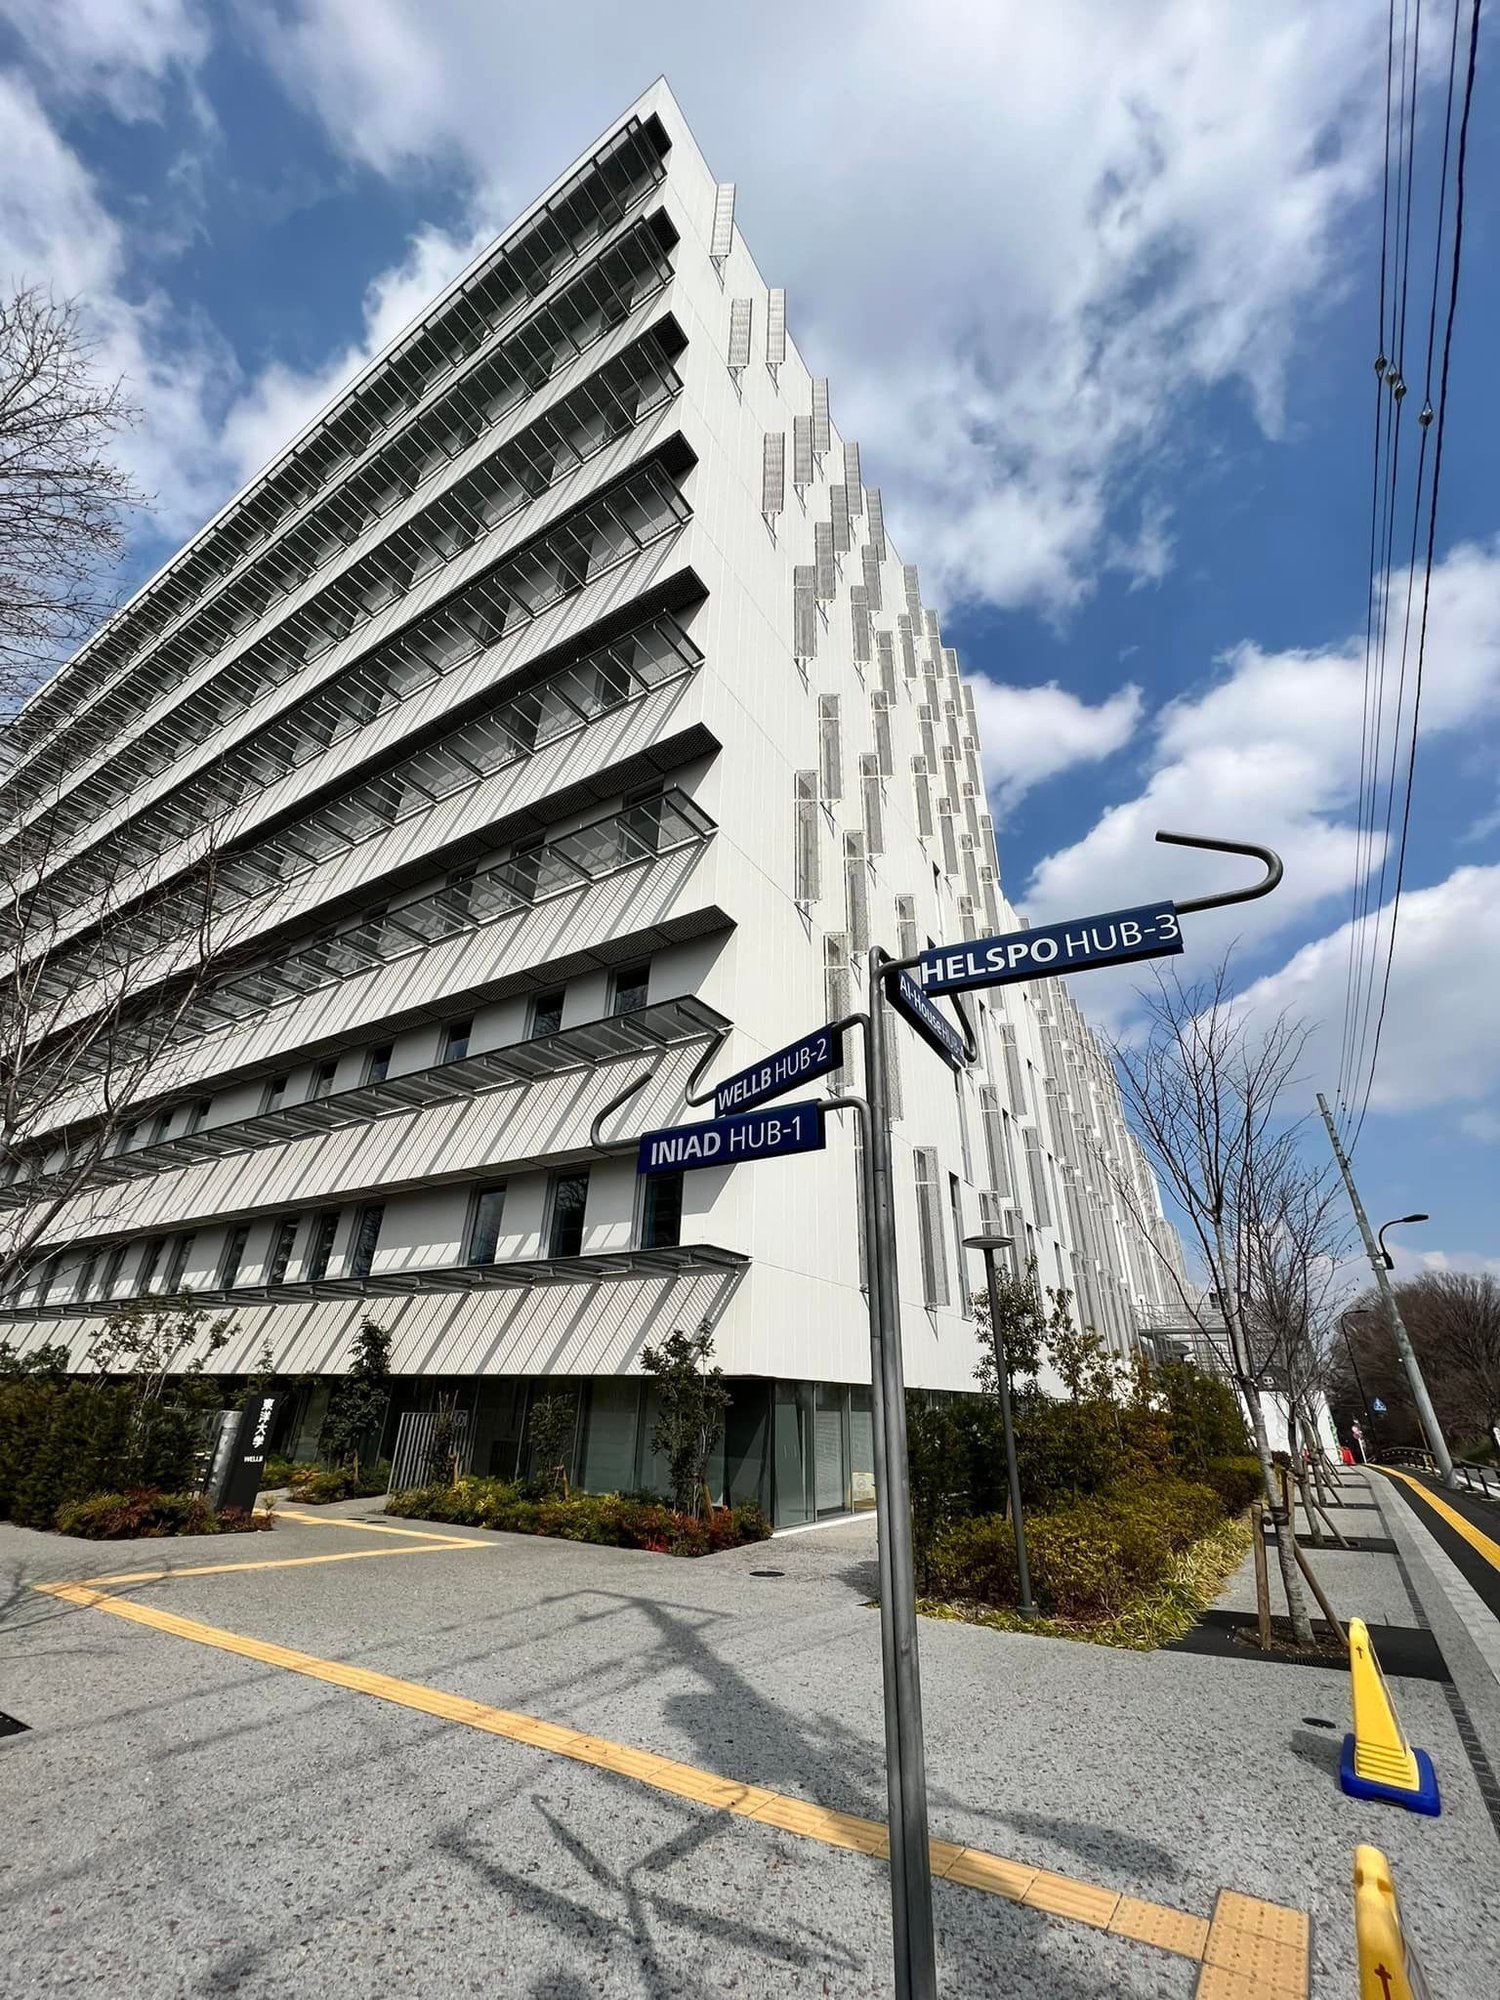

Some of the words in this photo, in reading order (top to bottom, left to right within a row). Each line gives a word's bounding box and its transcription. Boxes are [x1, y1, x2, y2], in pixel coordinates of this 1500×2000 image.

[921, 938, 1058, 985] HELSPO
[1065, 914, 1179, 957] HUB-3
[718, 1067, 771, 1110] WELLB
[775, 1038, 827, 1083] HUB-2
[651, 1132, 721, 1165] INIAD
[730, 1116, 801, 1152] HUB-1
[252, 1398, 275, 1448] 東洋大学
